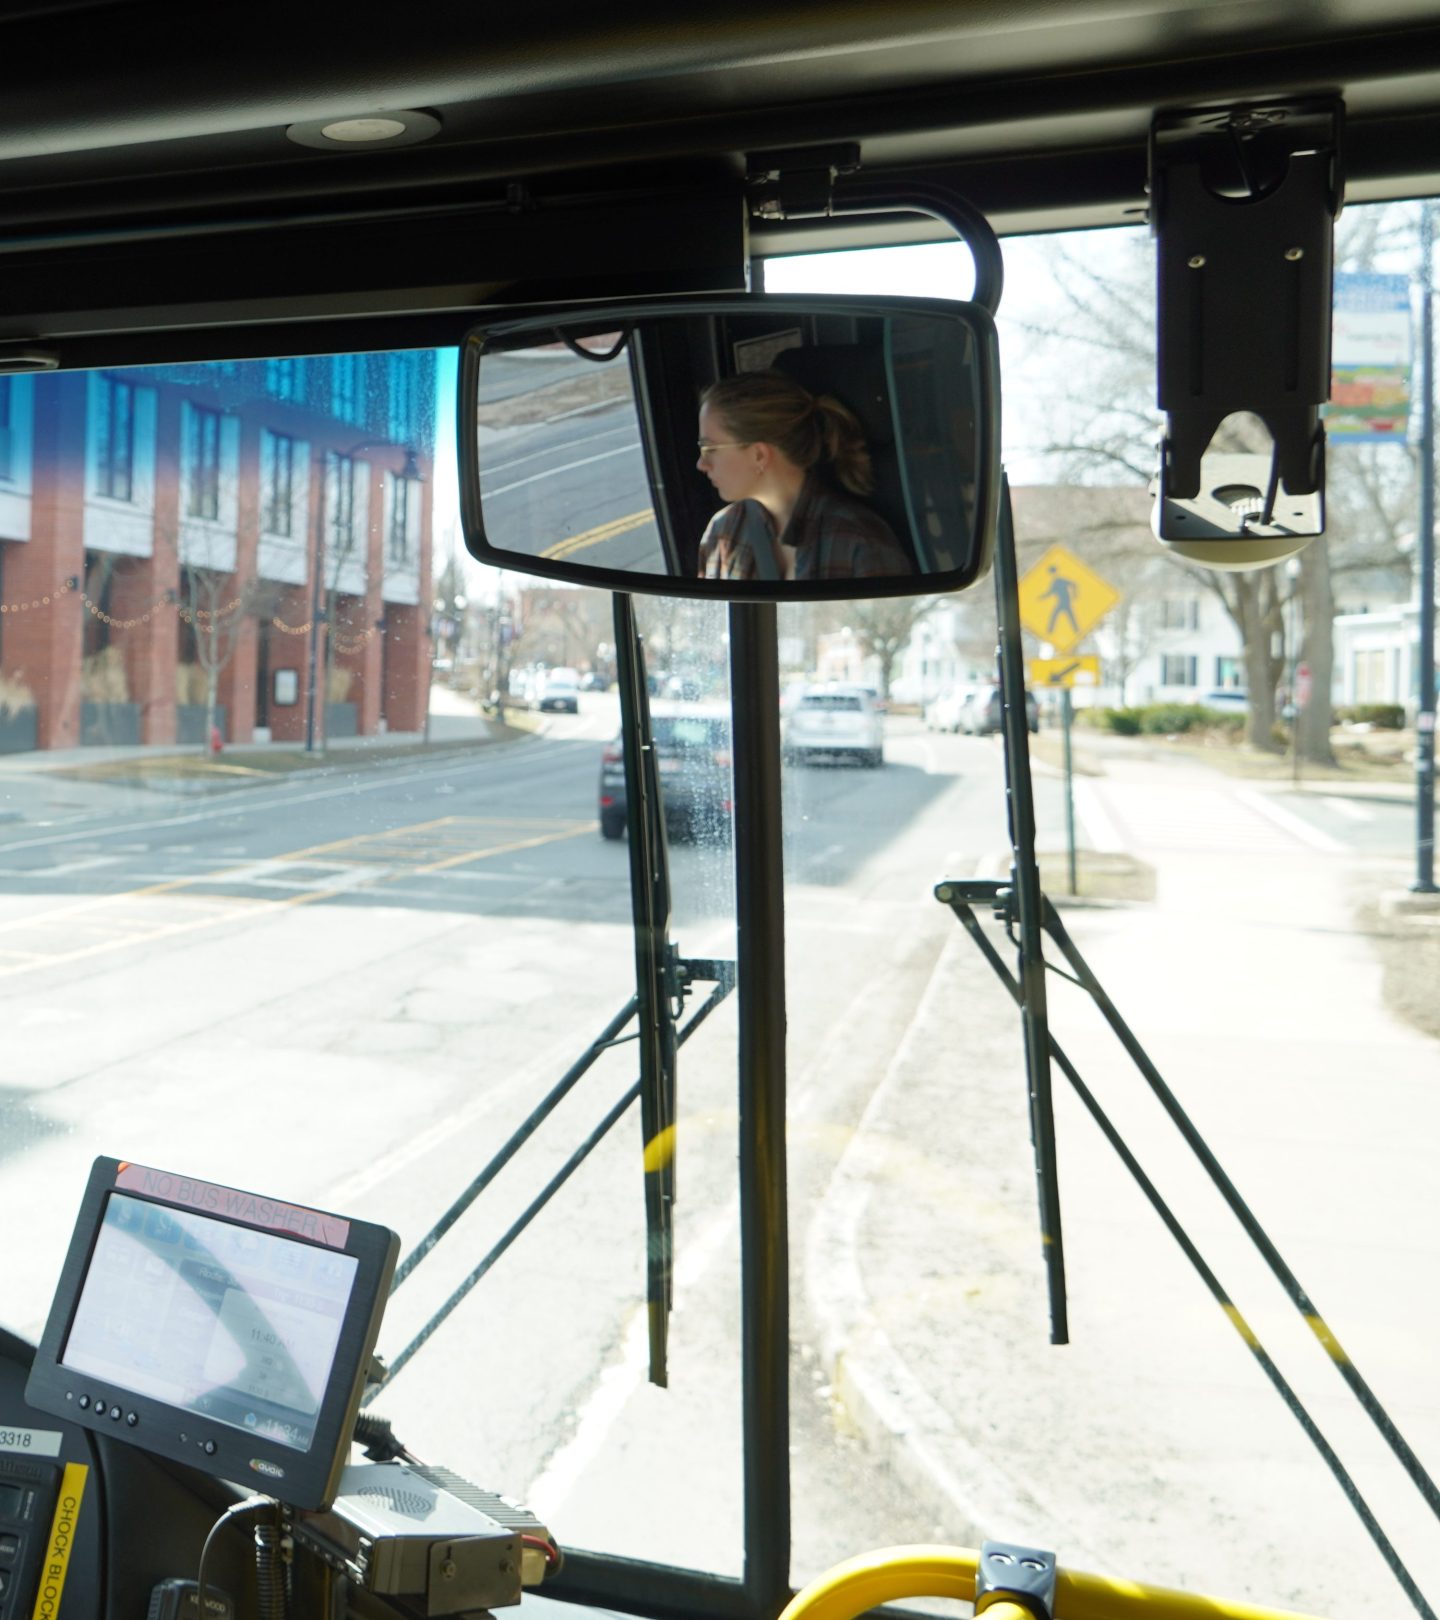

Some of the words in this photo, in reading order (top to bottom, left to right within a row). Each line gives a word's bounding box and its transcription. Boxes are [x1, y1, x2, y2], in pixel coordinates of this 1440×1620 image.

[142, 1171, 173, 1196] NO
[176, 1179, 220, 1209] BUS
[224, 1191, 319, 1236] WASHER
[52, 1496, 77, 1558] CHOCK
[39, 1564, 62, 1620] BLOCK
